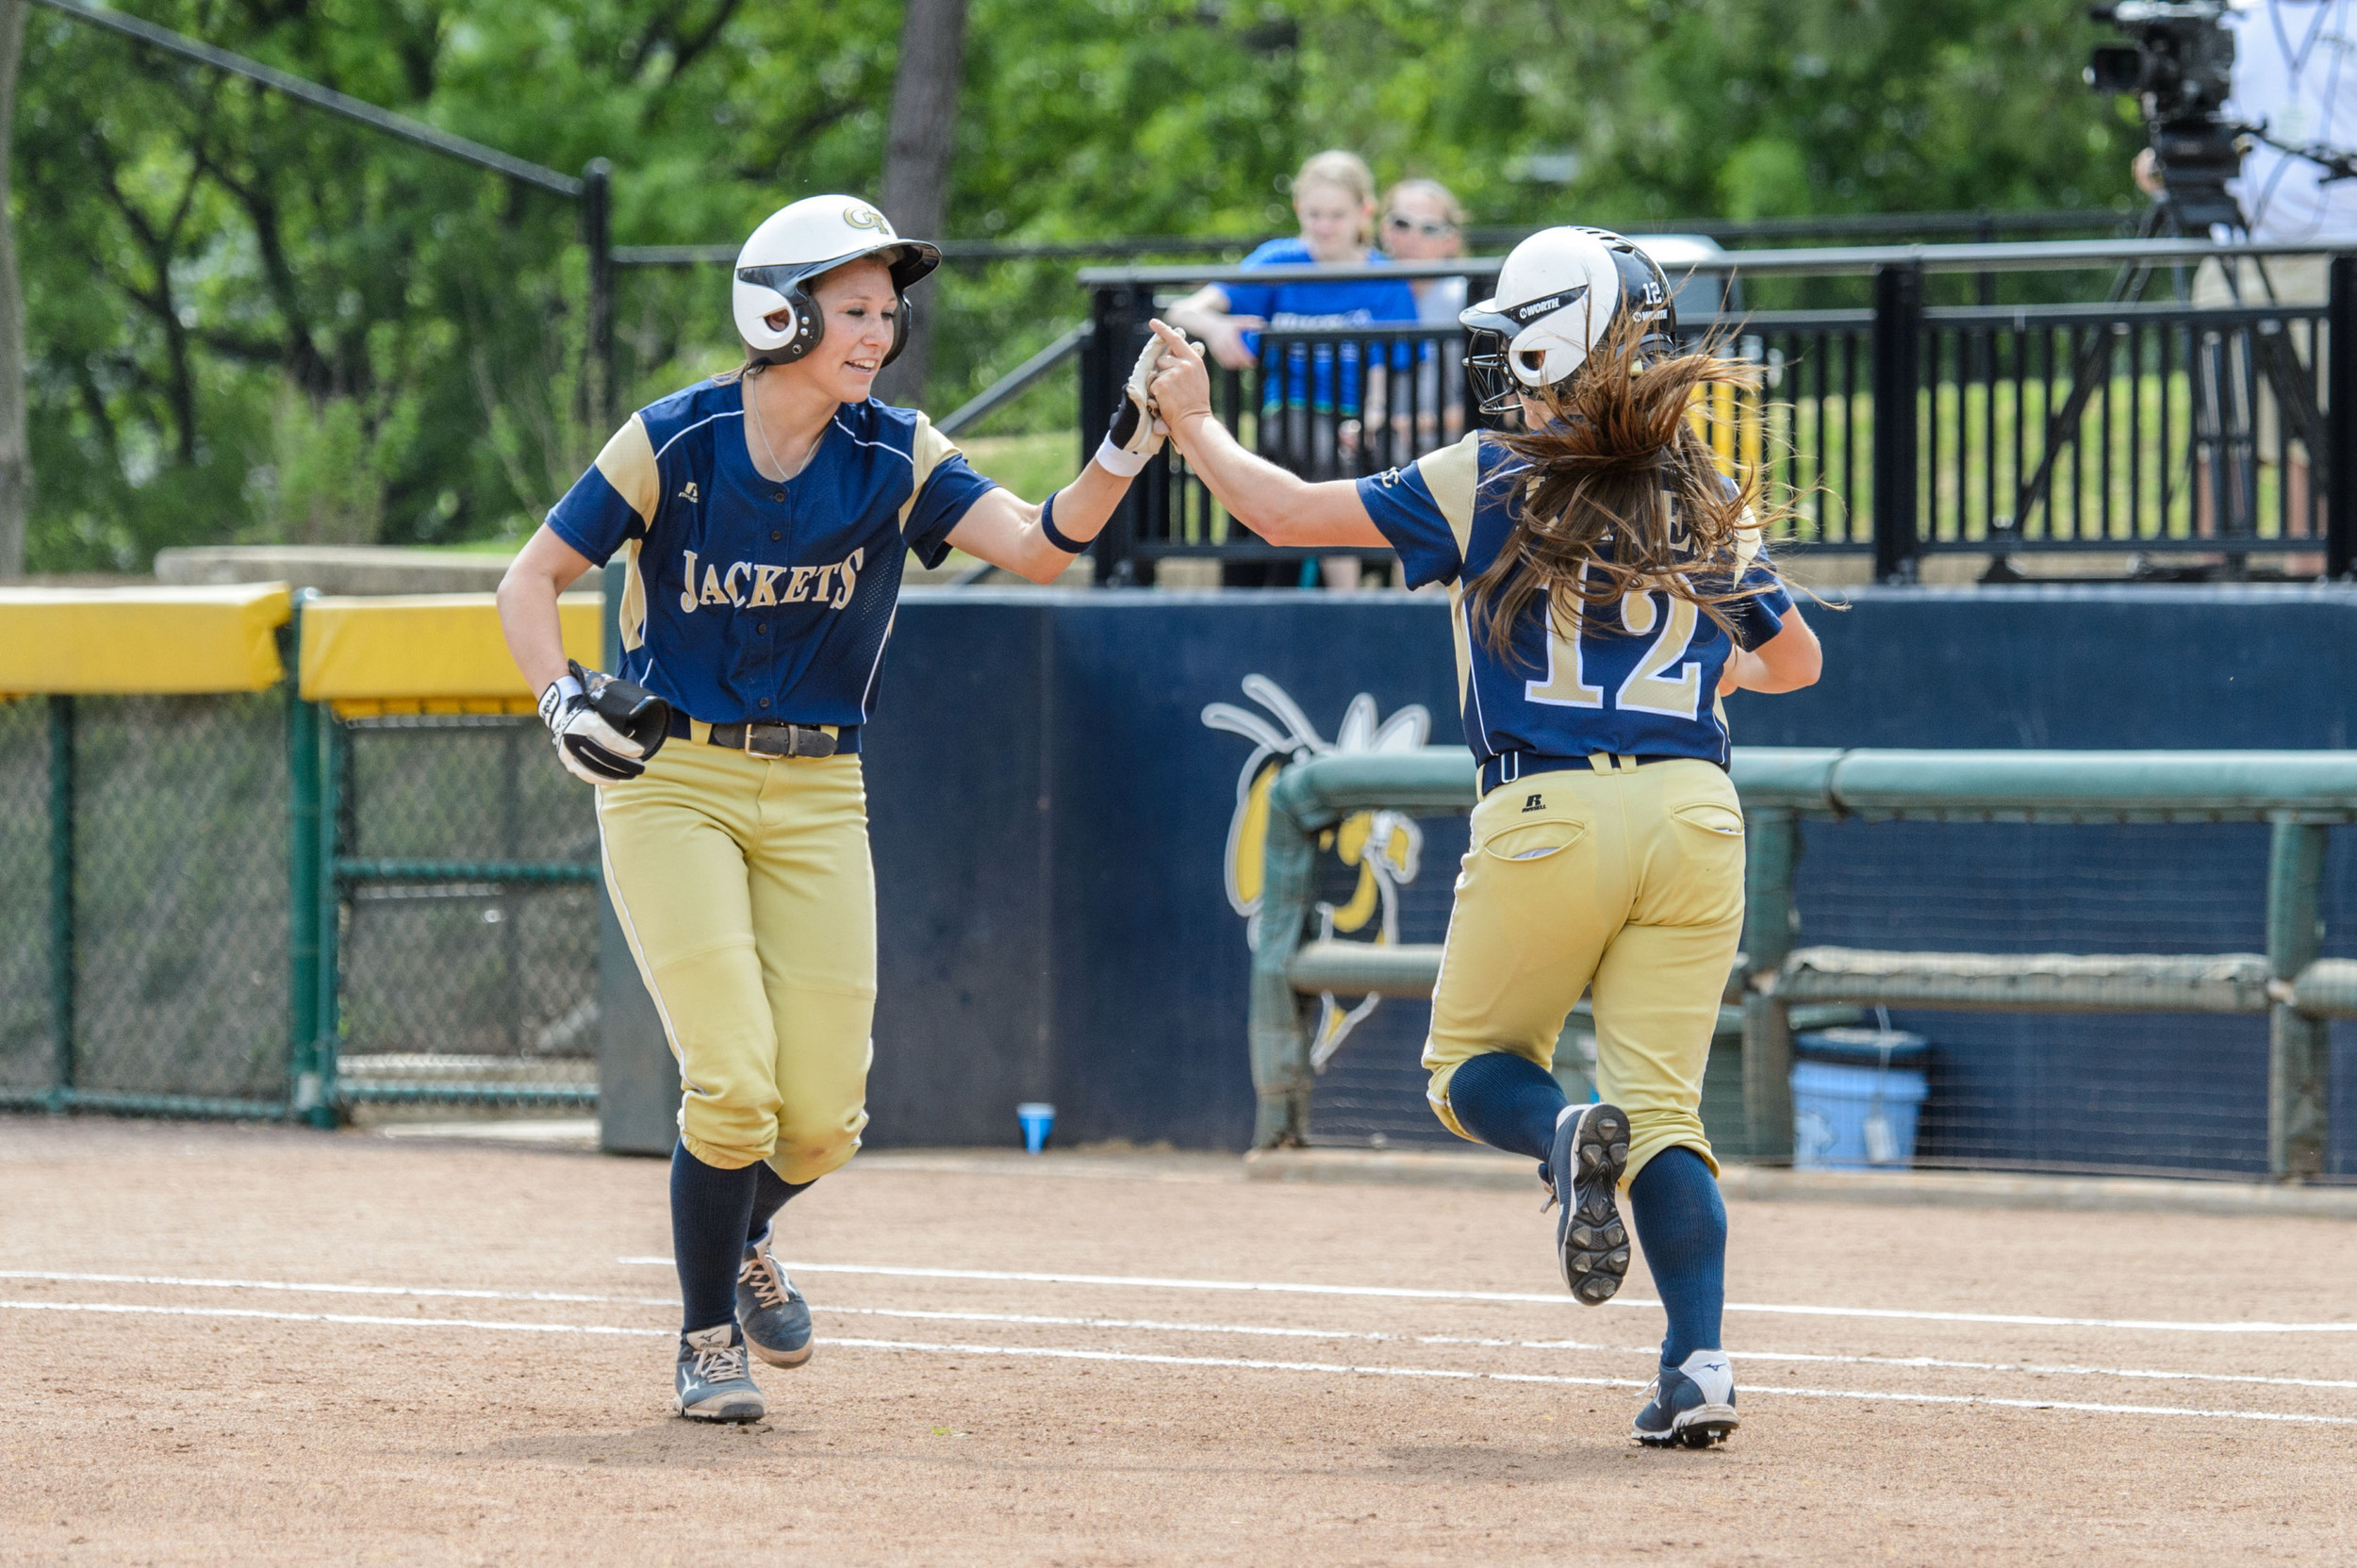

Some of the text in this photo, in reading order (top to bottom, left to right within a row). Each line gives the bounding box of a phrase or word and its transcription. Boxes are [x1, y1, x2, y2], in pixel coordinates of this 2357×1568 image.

[1526, 297, 1560, 317] WORTH
[1642, 282, 1662, 305] 12
[680, 547, 865, 613] JACKETS
[1525, 556, 1702, 721] 12
